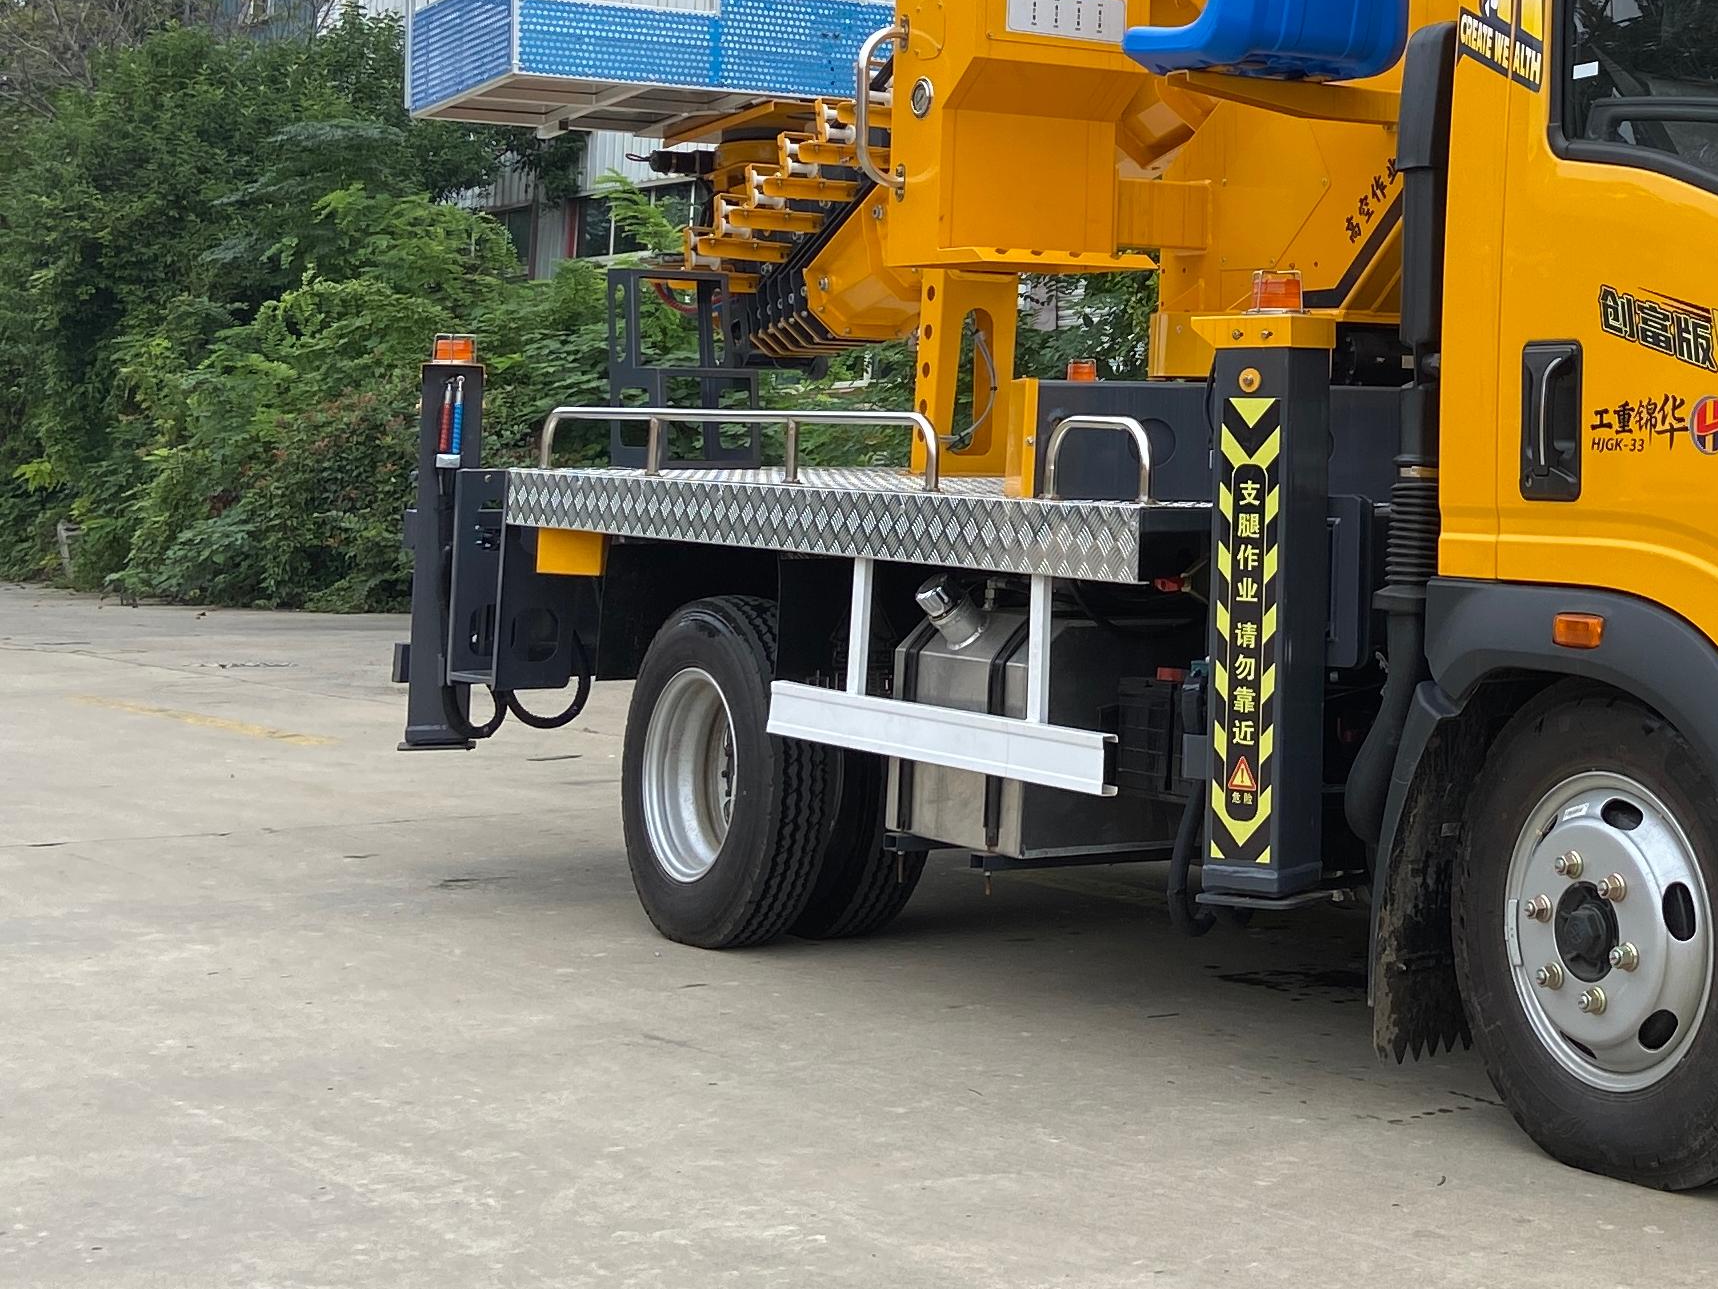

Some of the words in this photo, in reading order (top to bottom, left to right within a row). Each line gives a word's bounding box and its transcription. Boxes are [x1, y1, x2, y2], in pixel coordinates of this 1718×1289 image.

[1460, 13, 1495, 59] CREATE
[1598, 284, 1718, 373] 创富版
[1591, 437, 1645, 453] HJGK-33
[1236, 480, 1261, 603] 支腿作业
[1232, 621, 1258, 746] 请勿靠近
[1231, 791, 1253, 805] 危险
